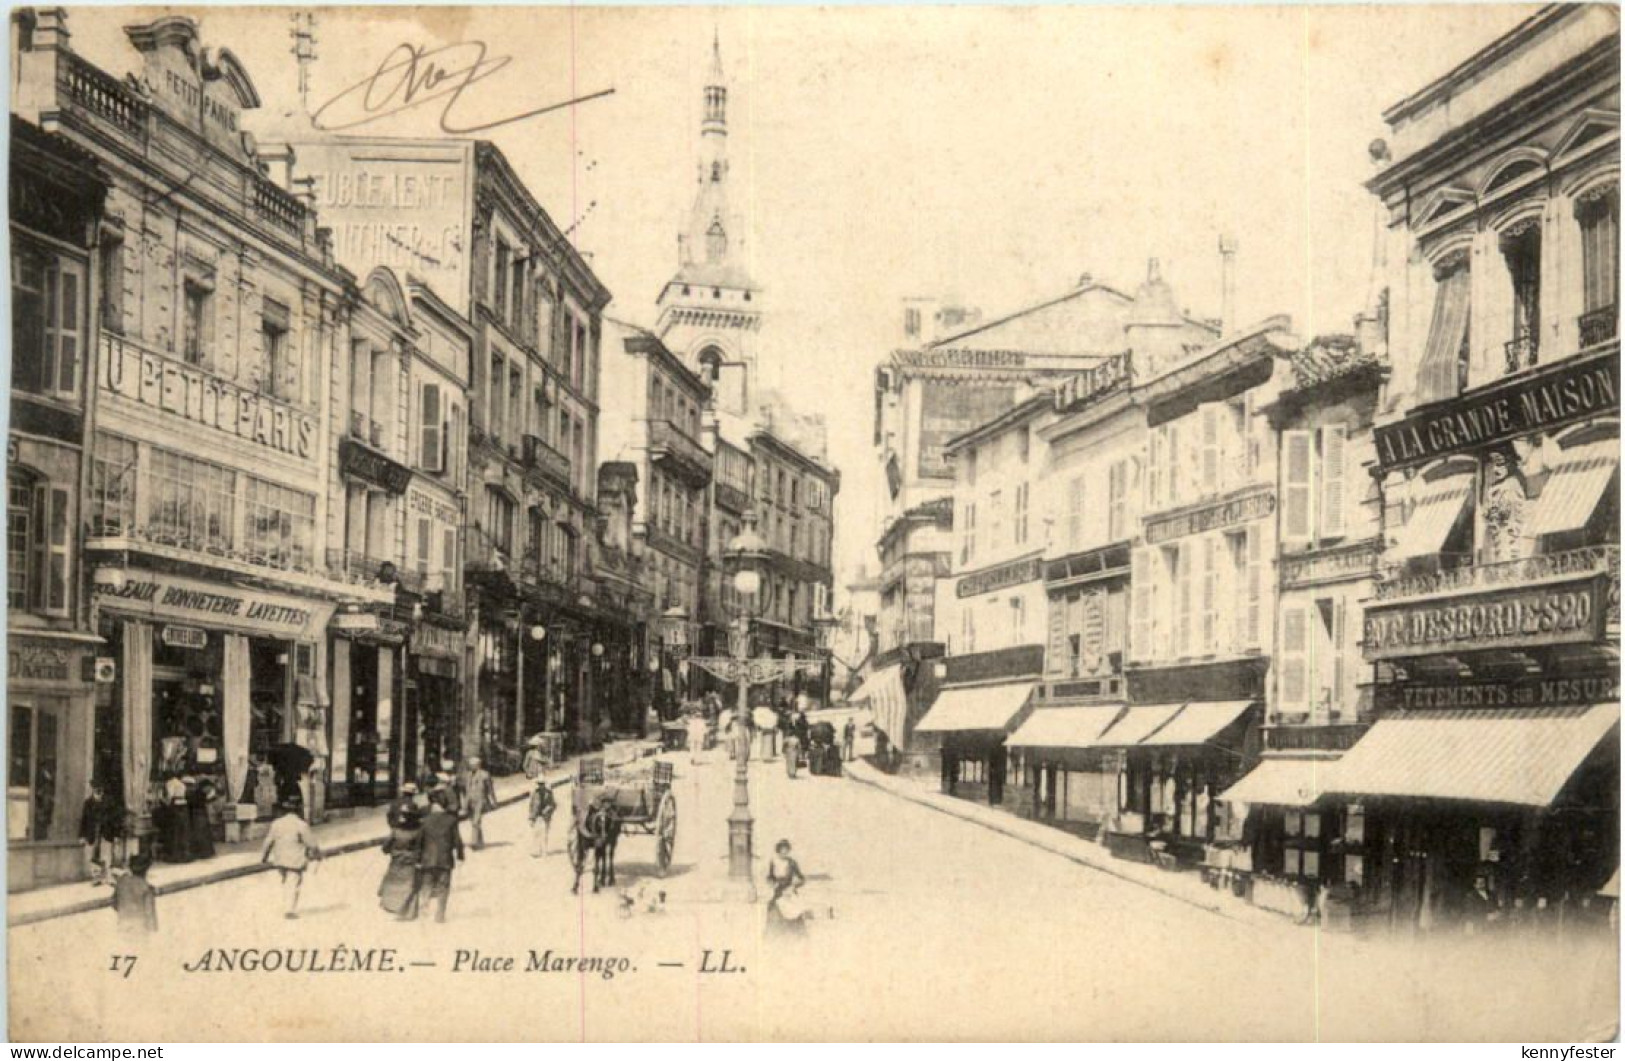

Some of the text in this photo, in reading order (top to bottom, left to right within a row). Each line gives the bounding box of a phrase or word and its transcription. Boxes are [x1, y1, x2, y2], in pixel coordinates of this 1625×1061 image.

[138, 350, 228, 431] PETIT
[235, 391, 311, 458] PARIS
[1384, 368, 1615, 462] A LA GRANDE MAISON
[162, 587, 245, 616] BONNETERIE
[246, 601, 311, 626] LAYETTES
[1412, 597, 1560, 645] DESBORDES
